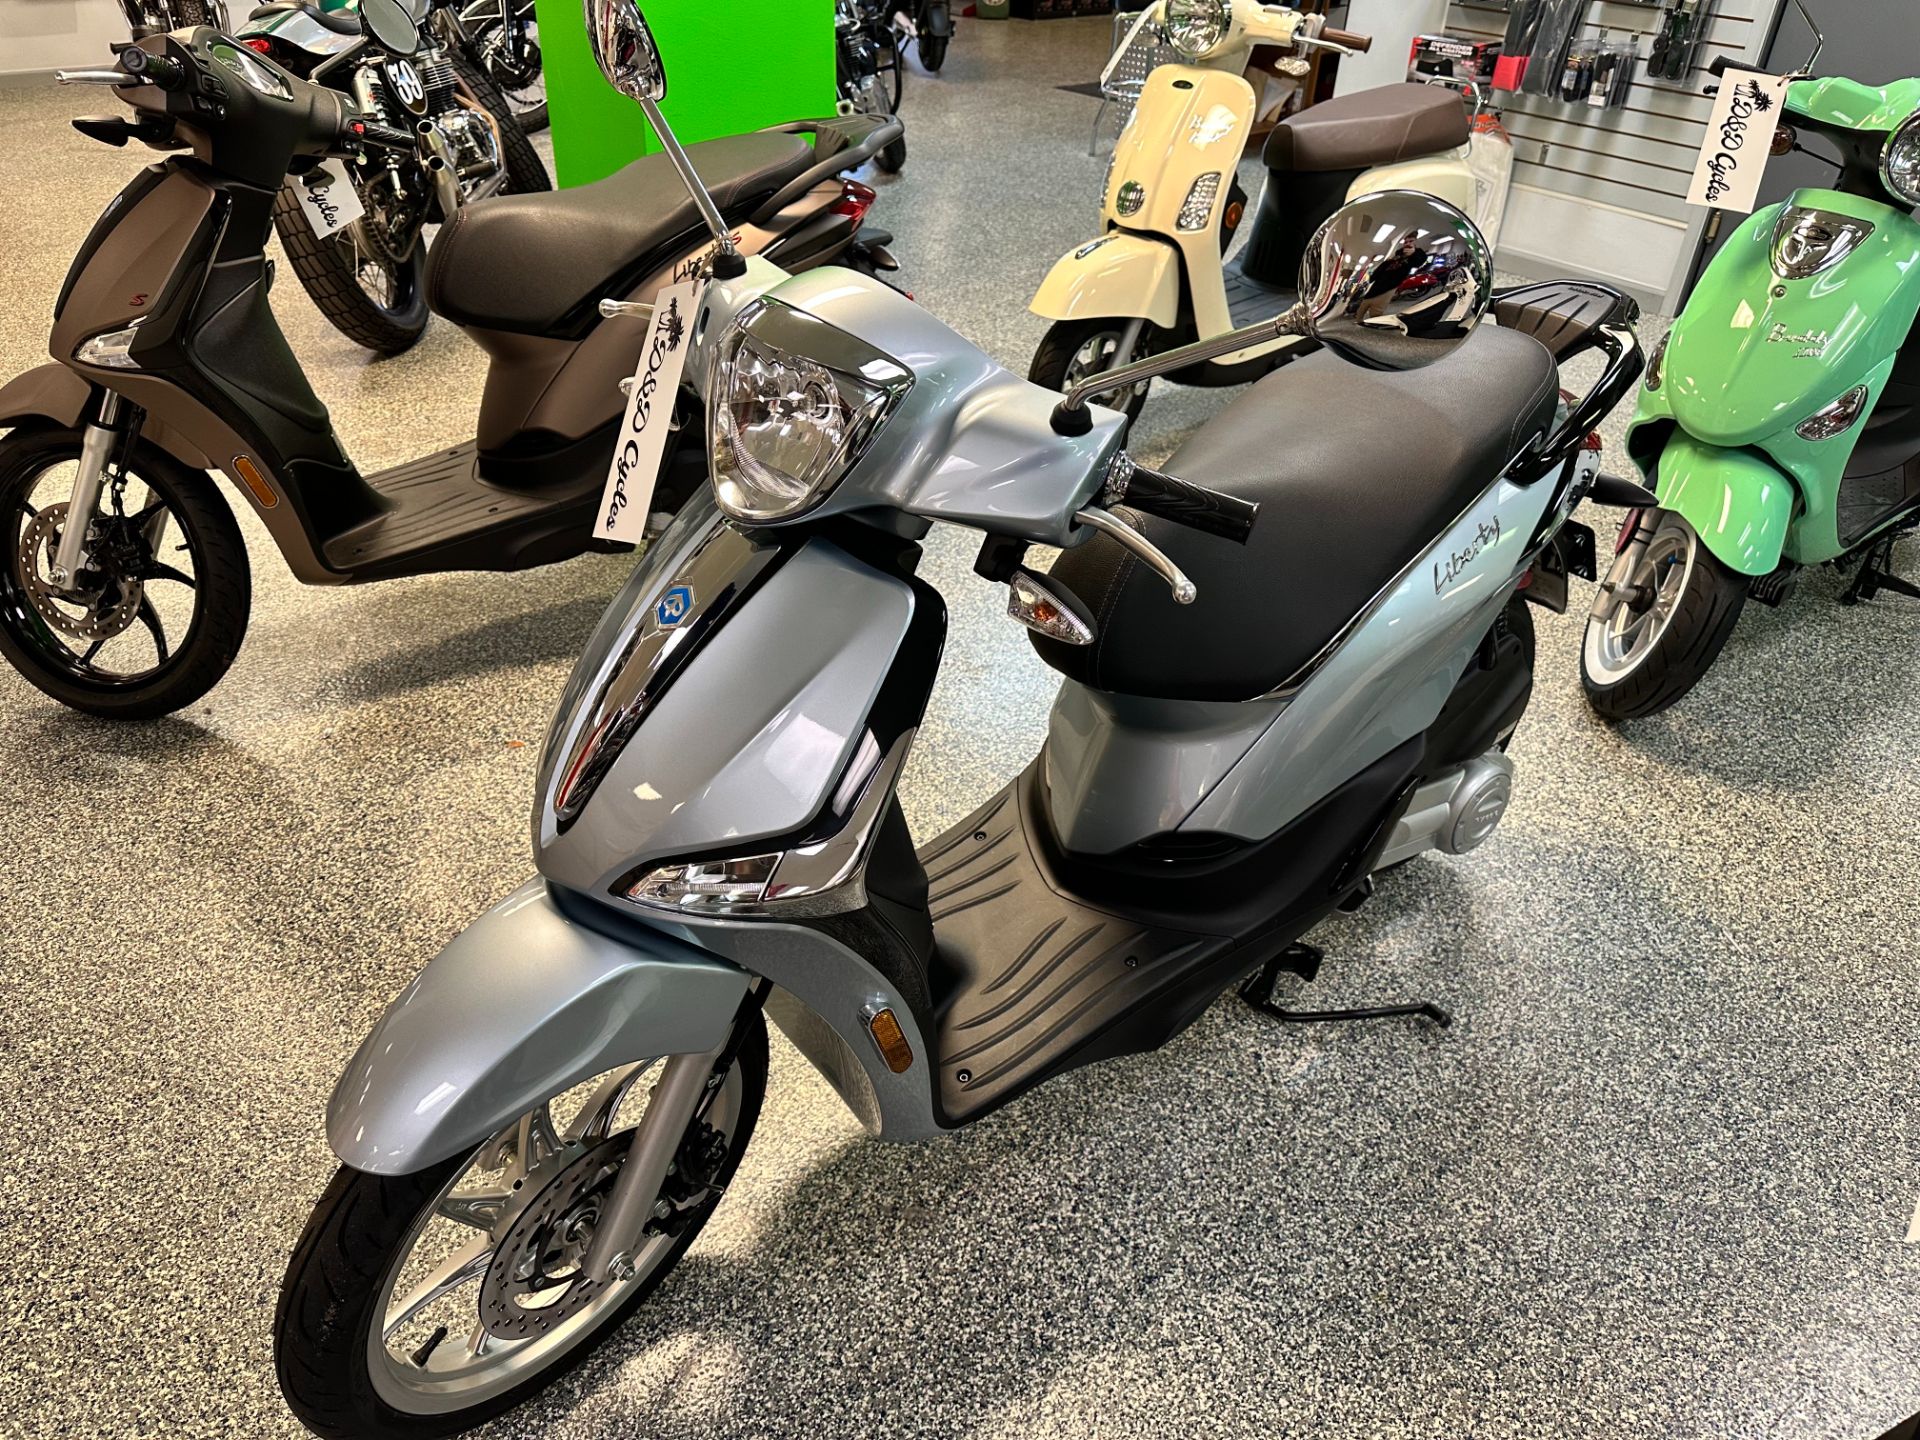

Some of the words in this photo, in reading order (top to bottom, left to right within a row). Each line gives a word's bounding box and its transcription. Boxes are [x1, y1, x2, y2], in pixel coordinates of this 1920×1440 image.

[1430, 41, 1474, 53] DEFENDER
[387, 59, 424, 105] 39
[1720, 97, 1753, 151] D&D
[1704, 152, 1737, 202] Cycles
[306, 185, 340, 228] Cycles
[129, 293, 149, 307] S
[1765, 322, 1834, 350] Buddy
[632, 339, 667, 434] D&D
[606, 443, 639, 533] Cycles
[1433, 515, 1501, 595] Liberty
